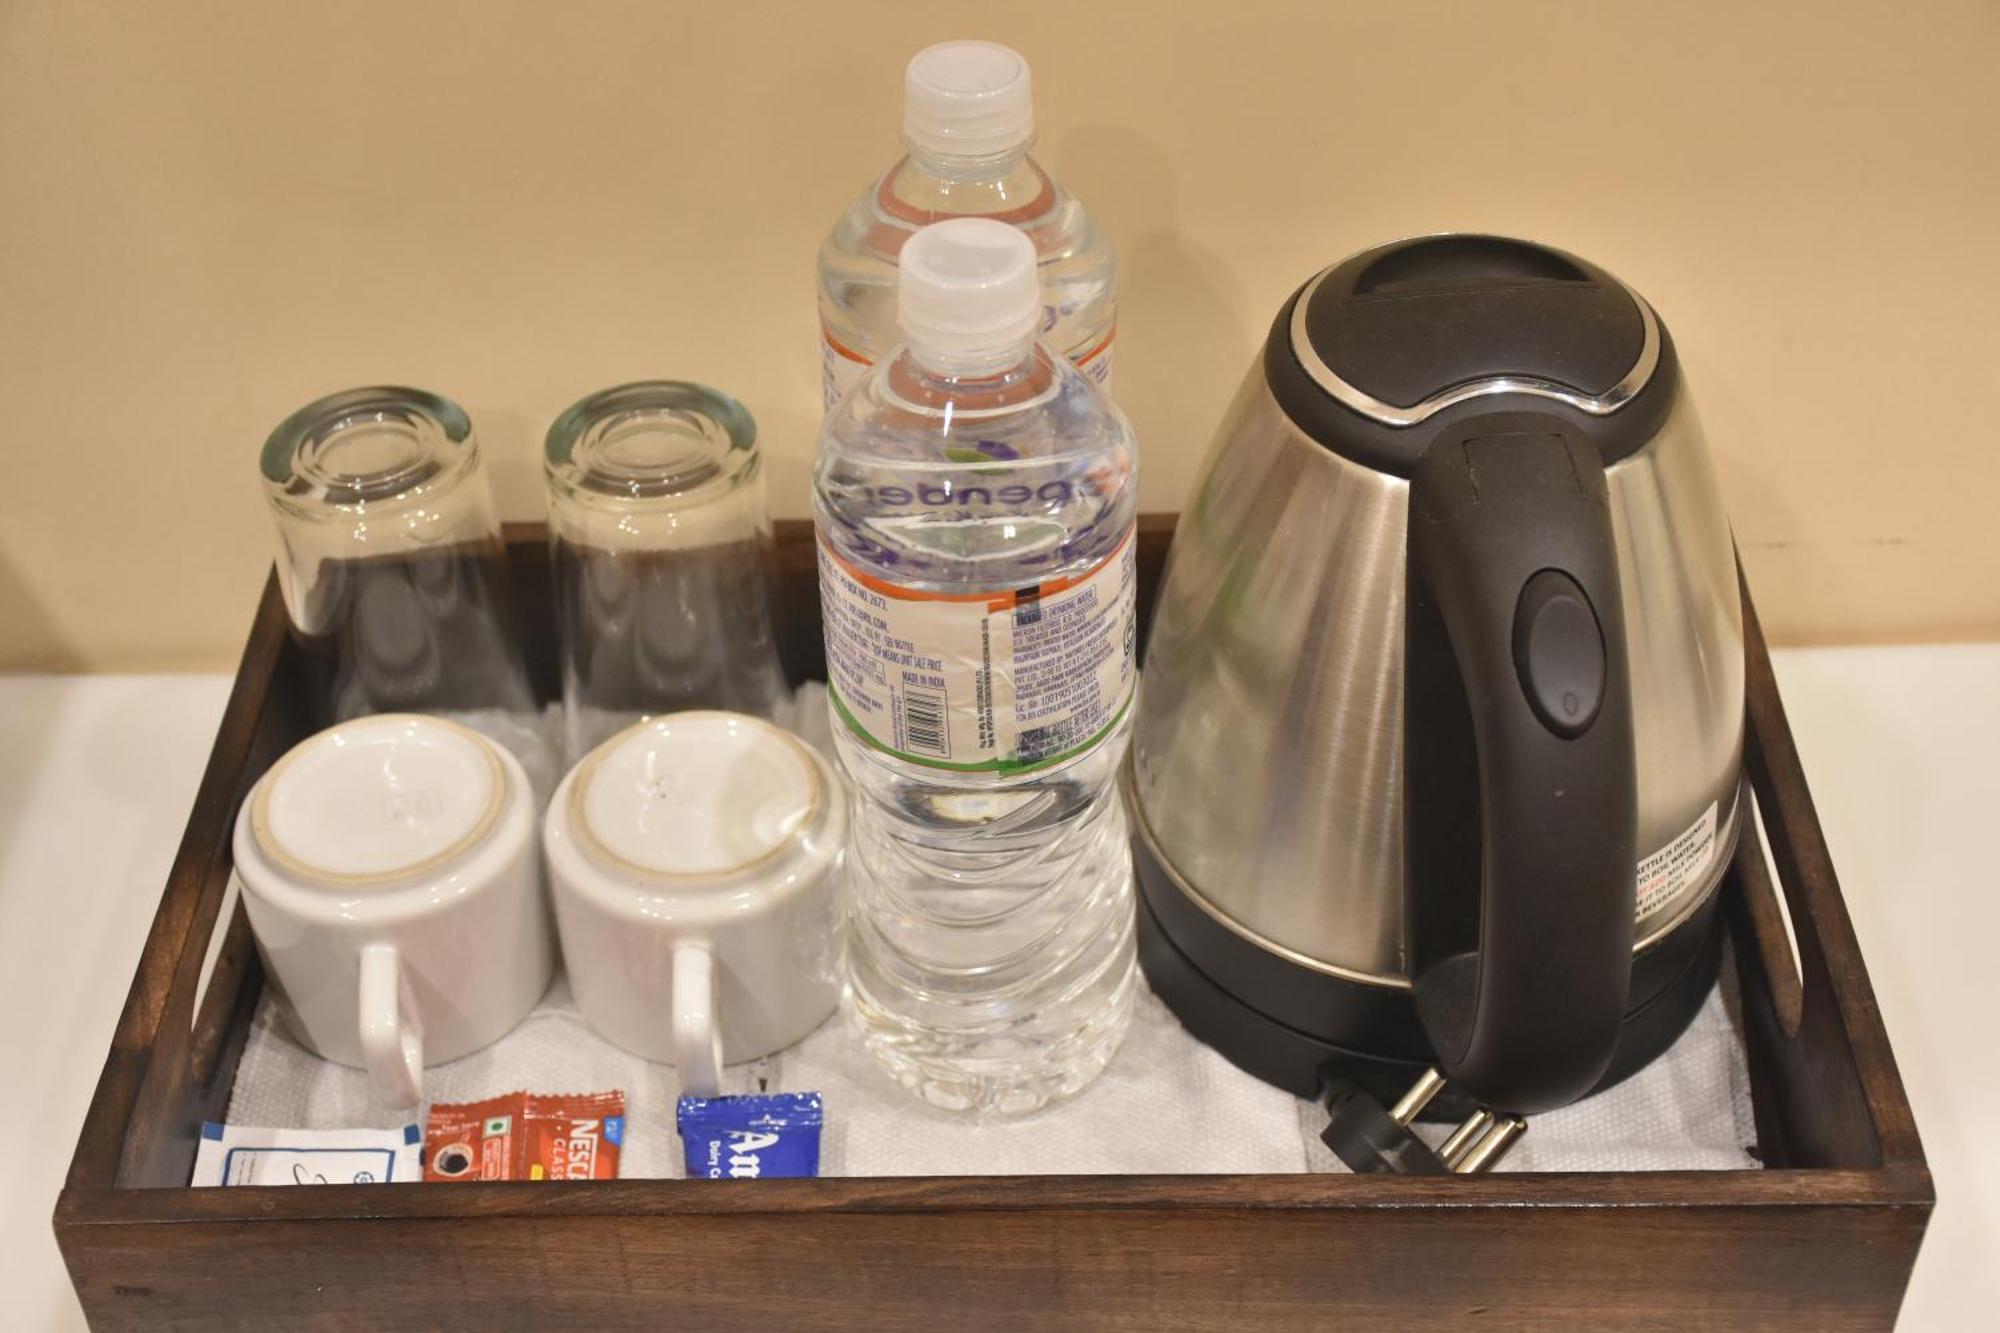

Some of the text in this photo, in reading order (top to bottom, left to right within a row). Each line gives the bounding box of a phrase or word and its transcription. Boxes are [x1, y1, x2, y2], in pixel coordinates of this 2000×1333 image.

[902, 670, 918, 683] MADE
[1674, 819, 1706, 852] DESIGNED
[707, 1140, 722, 1166] Dairy
